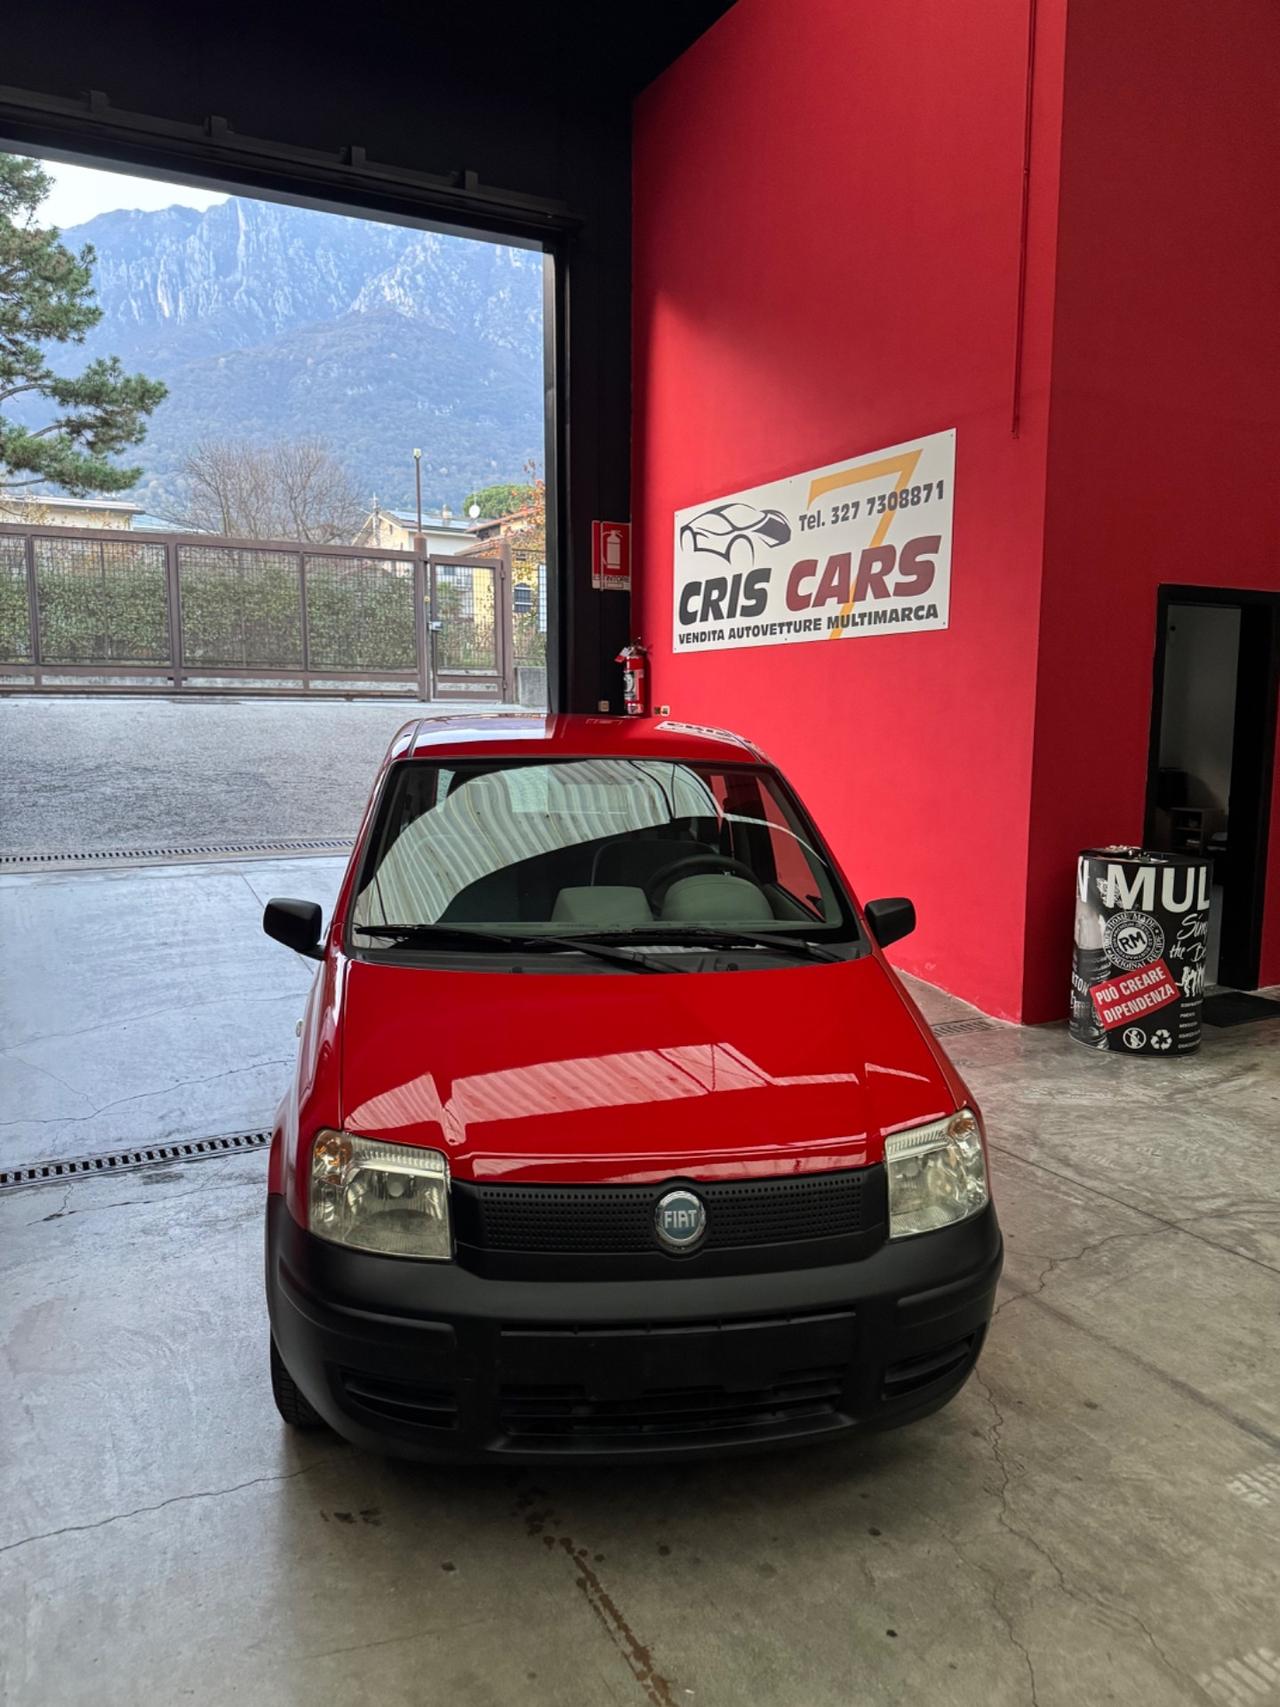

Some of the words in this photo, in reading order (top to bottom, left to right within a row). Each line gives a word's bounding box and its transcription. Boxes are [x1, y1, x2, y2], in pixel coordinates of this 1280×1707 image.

[799, 510, 826, 531] Tel.
[831, 501, 860, 524] 327
[866, 480, 944, 516] 7308871
[679, 568, 772, 625] CRIS
[785, 535, 942, 612] CARS
[679, 629, 725, 644] VENDITA
[728, 618, 822, 640] AUTOVETTURE
[827, 604, 938, 629] MULTIMARCA
[1118, 931, 1146, 952] RM
[1095, 983, 1119, 1005] PUÒ
[1119, 966, 1166, 996] CREARE
[1103, 983, 1175, 1023] DIPENDENZA
[664, 1209, 697, 1229] FIAT
